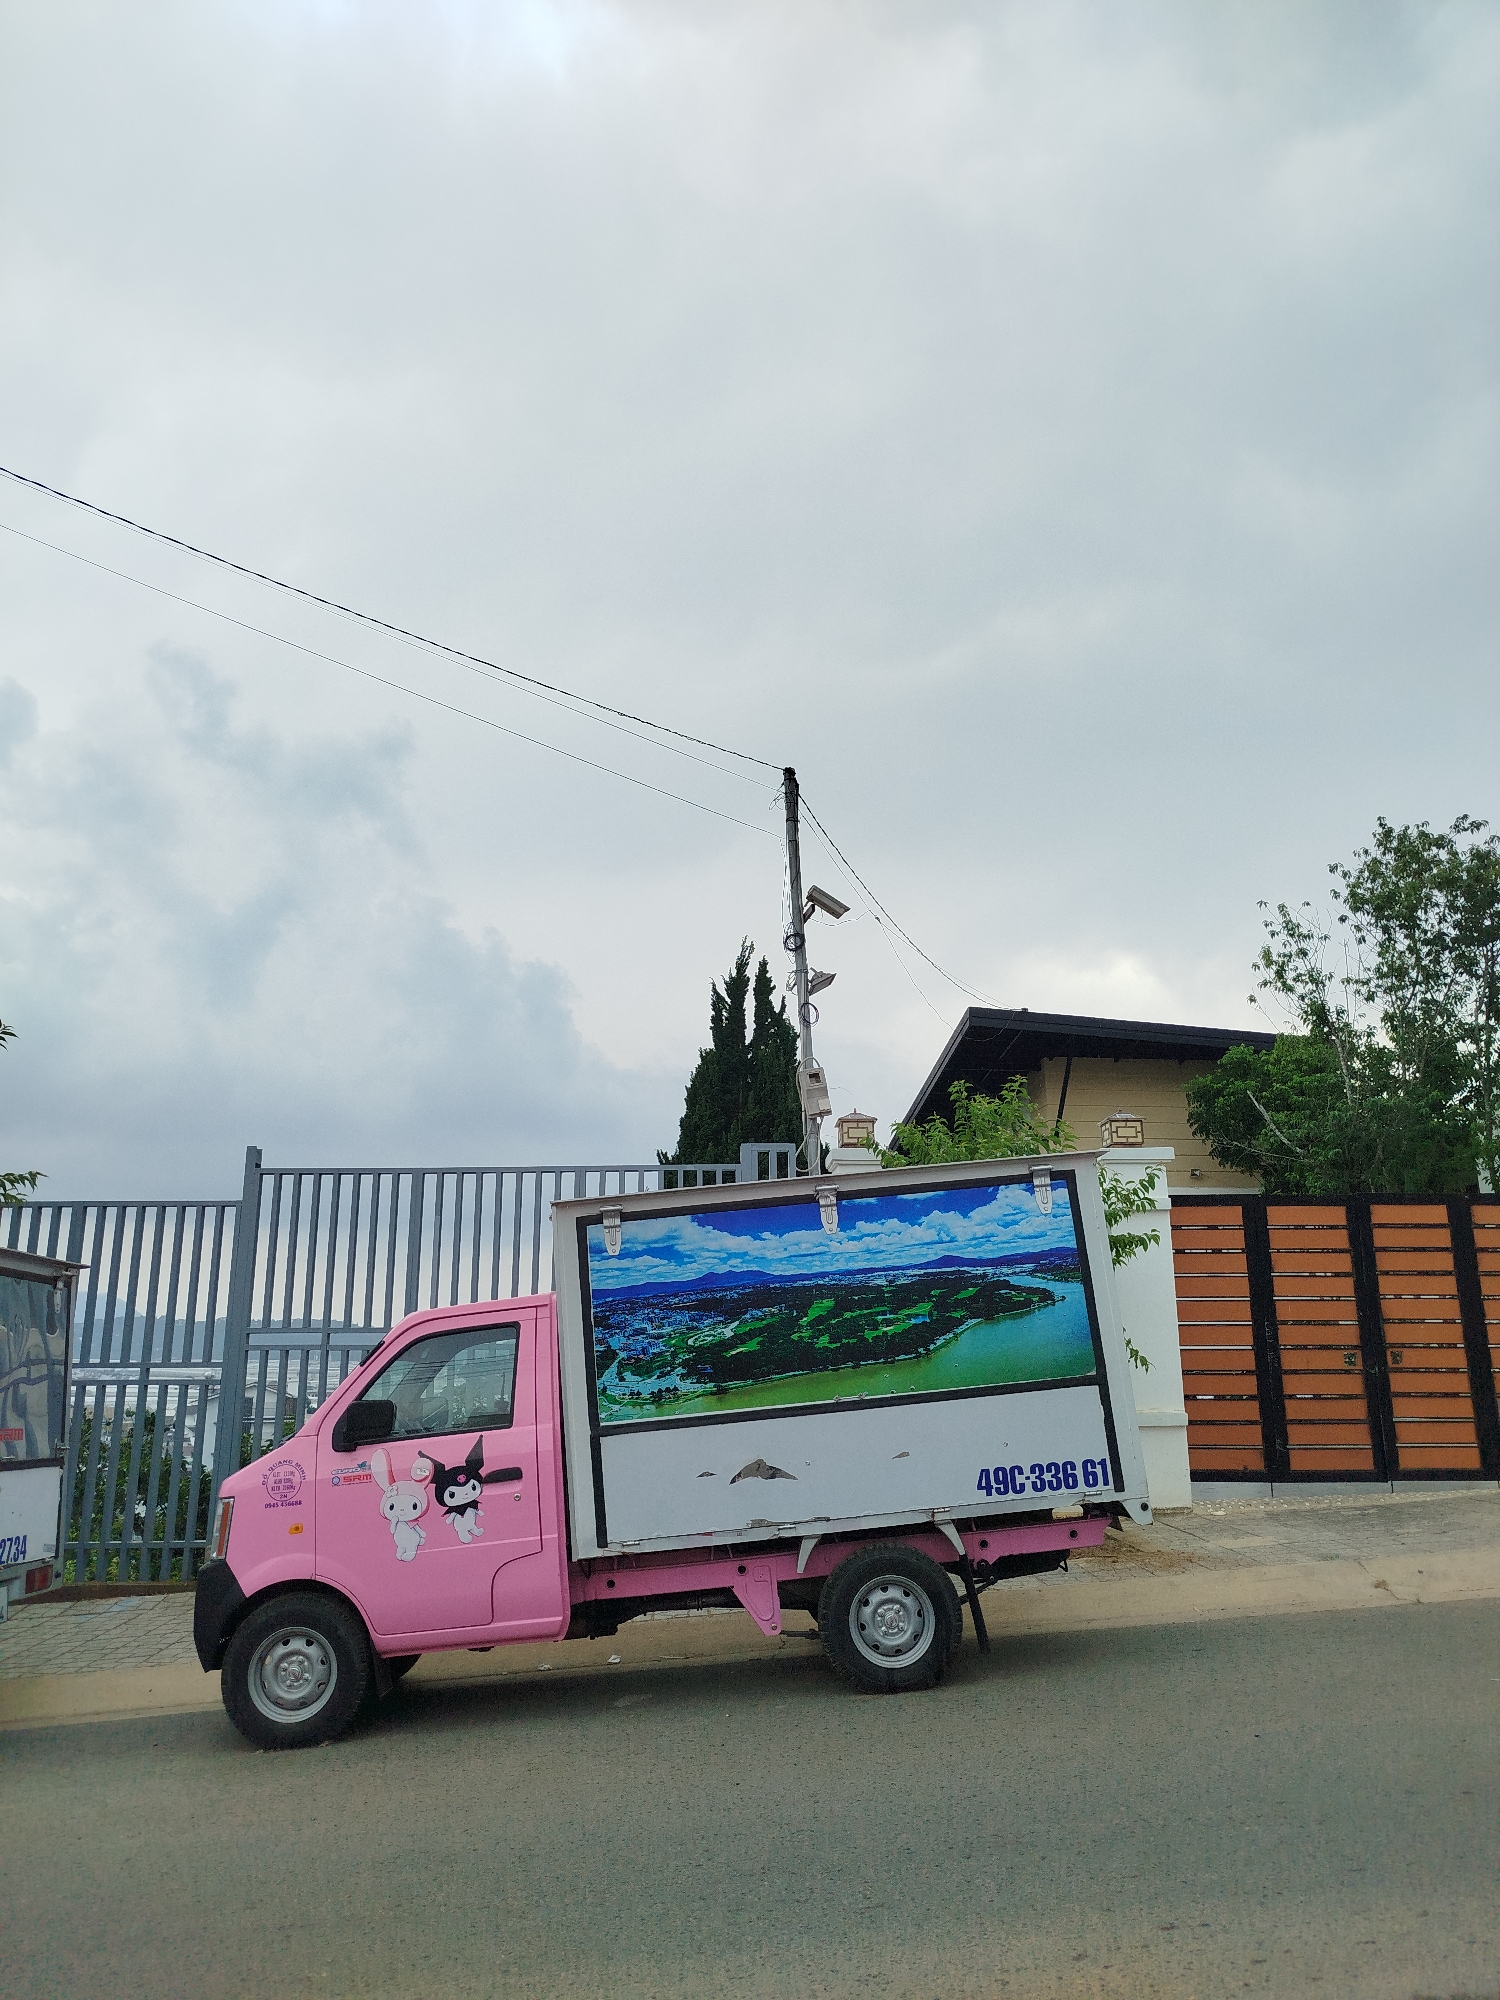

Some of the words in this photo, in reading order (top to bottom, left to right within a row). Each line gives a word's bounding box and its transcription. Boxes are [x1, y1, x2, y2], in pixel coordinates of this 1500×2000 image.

[0, 1428, 24, 1440] RM
[268, 1459, 293, 1472] QUANG
[294, 1462, 307, 1481] MINH
[343, 1474, 372, 1483] SRM
[1081, 1458, 1110, 1488] 61
